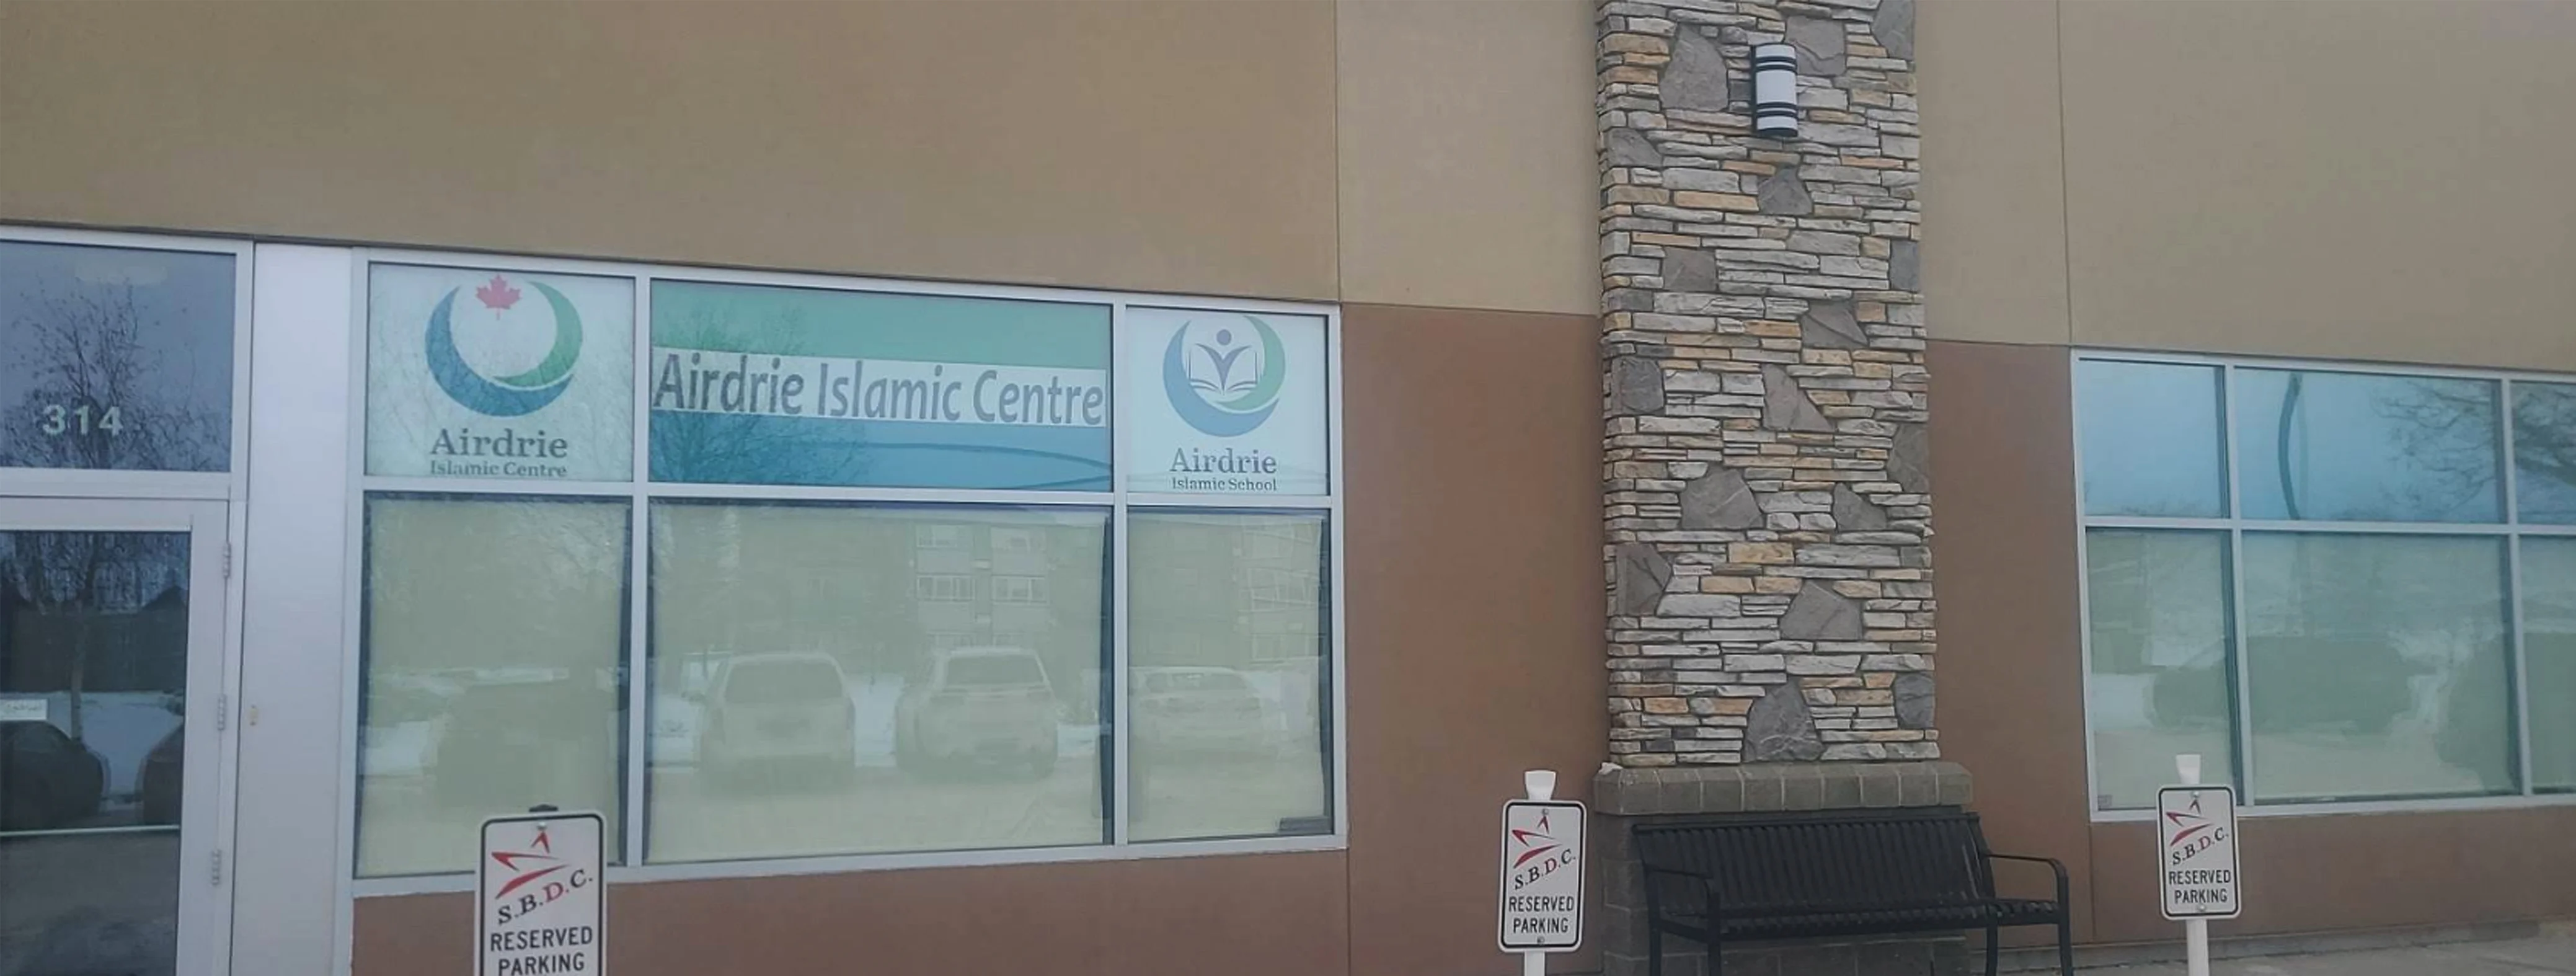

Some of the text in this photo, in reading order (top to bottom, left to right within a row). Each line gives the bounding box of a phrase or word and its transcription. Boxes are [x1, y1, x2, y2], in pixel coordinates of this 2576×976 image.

[652, 352, 1105, 425] Airdrie Islamic Centre
[43, 403, 124, 435] 314
[430, 428, 569, 459] Airdrie
[430, 459, 568, 477] Islamic Centre
[1169, 447, 1278, 474] Airdrie
[1172, 477, 1278, 492] Islamic School
[2172, 827, 2229, 866] S.B.D.C.
[1513, 848, 1577, 890] S.B.D.C.
[2169, 869, 2231, 885] RESERVED
[497, 869, 593, 925] S.B.D.C.
[1508, 896, 1575, 912] RESERVED
[2174, 889, 2228, 904] PARKING
[490, 926, 593, 952] RESERVED
[1513, 918, 1569, 934] PARKING
[498, 952, 585, 976] PARKING
